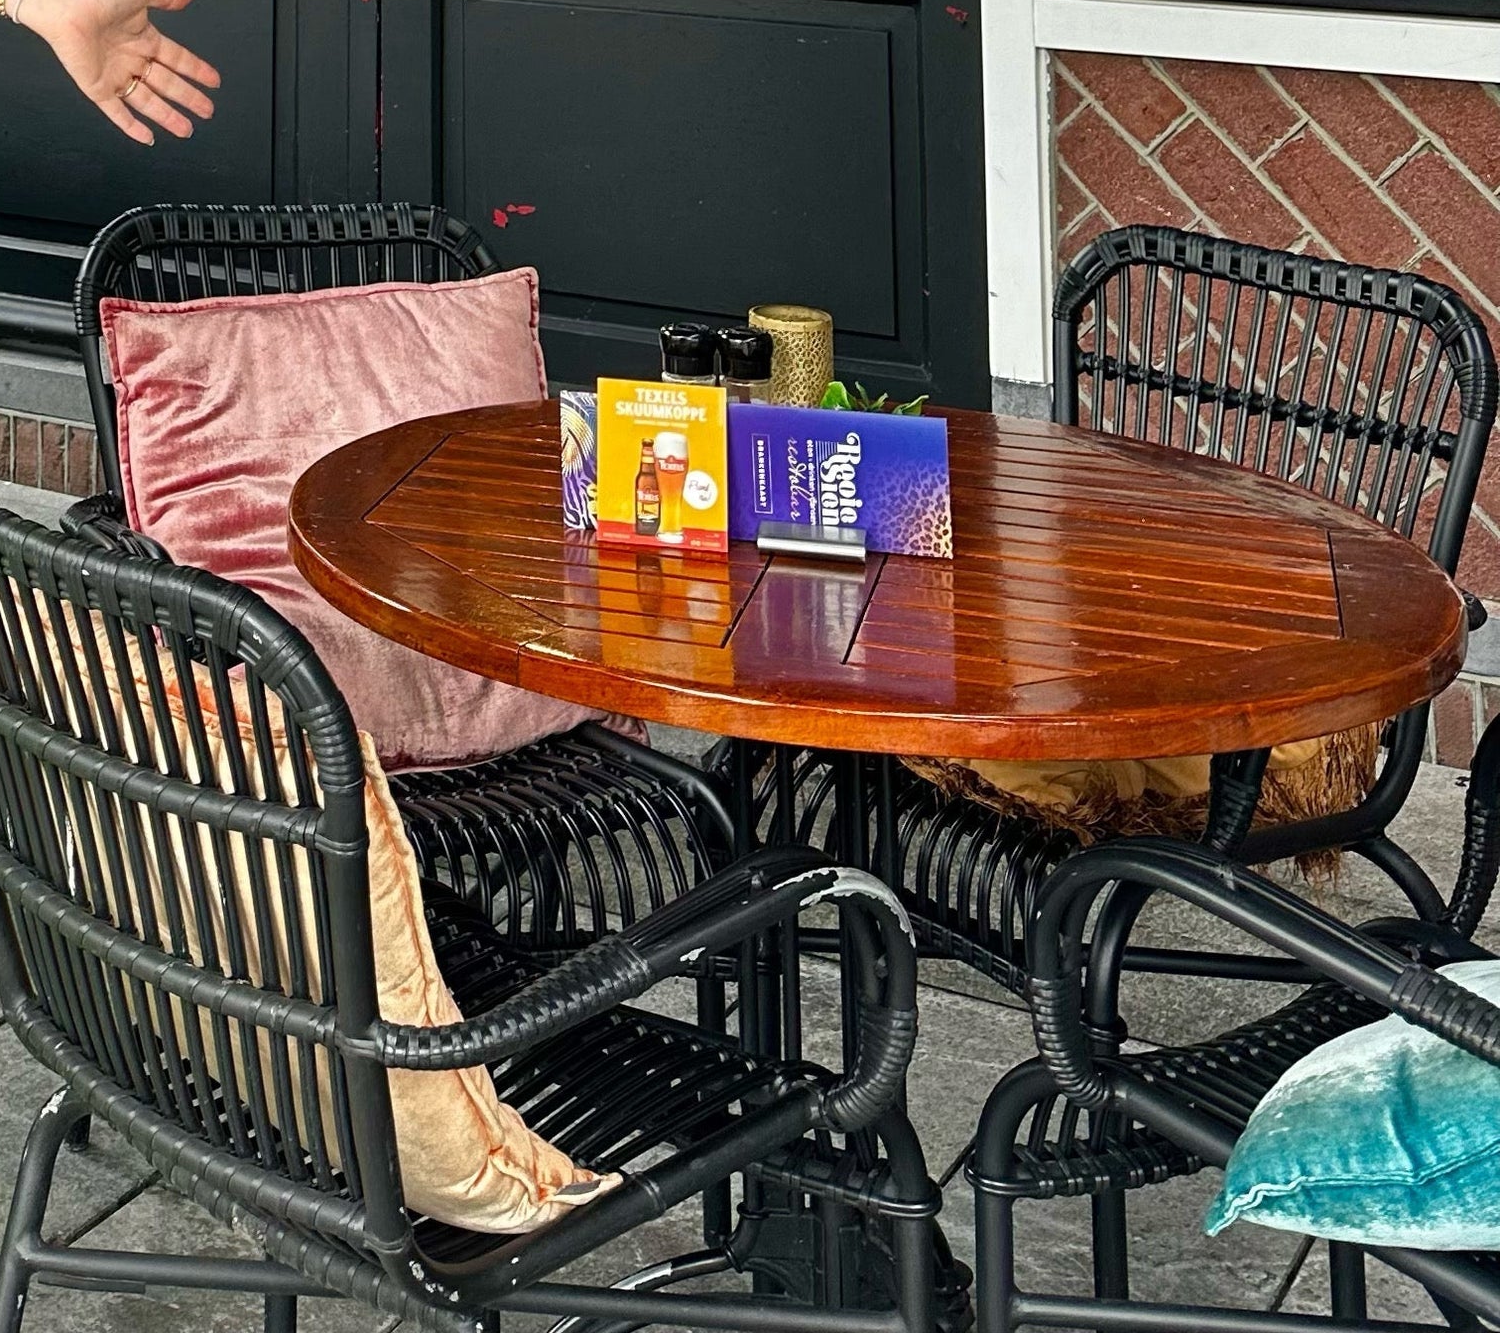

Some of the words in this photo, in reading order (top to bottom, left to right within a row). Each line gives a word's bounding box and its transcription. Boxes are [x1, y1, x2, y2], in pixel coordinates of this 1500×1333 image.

[615, 400, 707, 422] SKUUMKOPPE
[634, 387, 688, 406] TEXELS
[820, 464, 841, 525] Sien
[837, 432, 862, 524] Rooie
